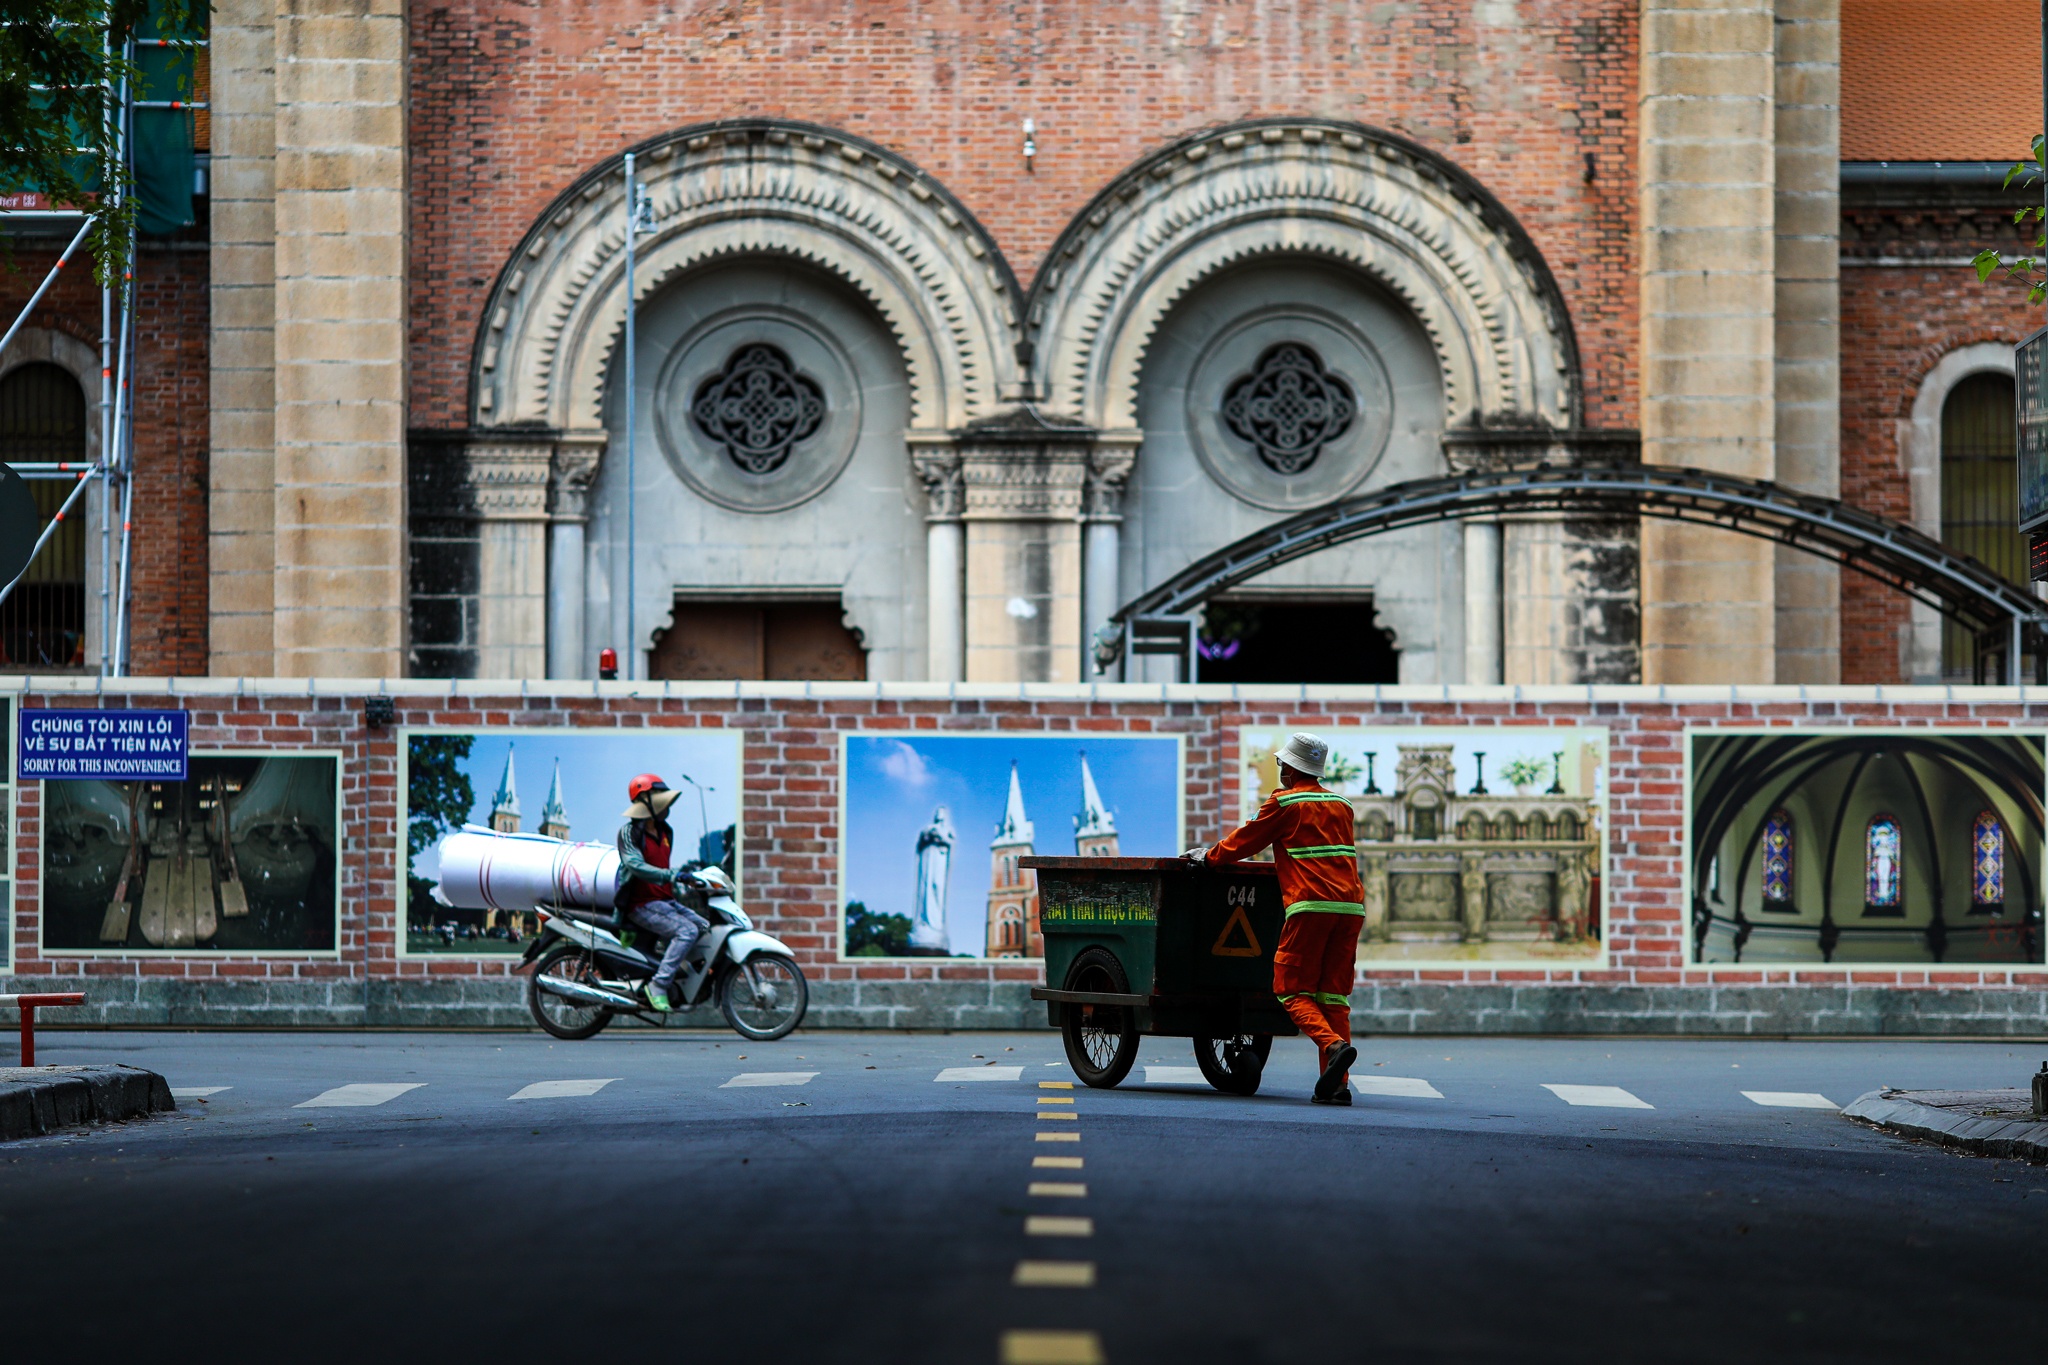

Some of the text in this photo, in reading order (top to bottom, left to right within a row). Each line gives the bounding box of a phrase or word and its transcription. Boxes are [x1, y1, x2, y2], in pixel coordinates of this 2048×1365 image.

[31, 715, 172, 734] CHÚNG TÔI XIN LỖI
[111, 736, 146, 754] TIỆN
[150, 735, 182, 752] NÀY
[23, 758, 182, 773] SORRY FOR THIS INCONVENIENCE
[1227, 885, 1256, 907] C44
